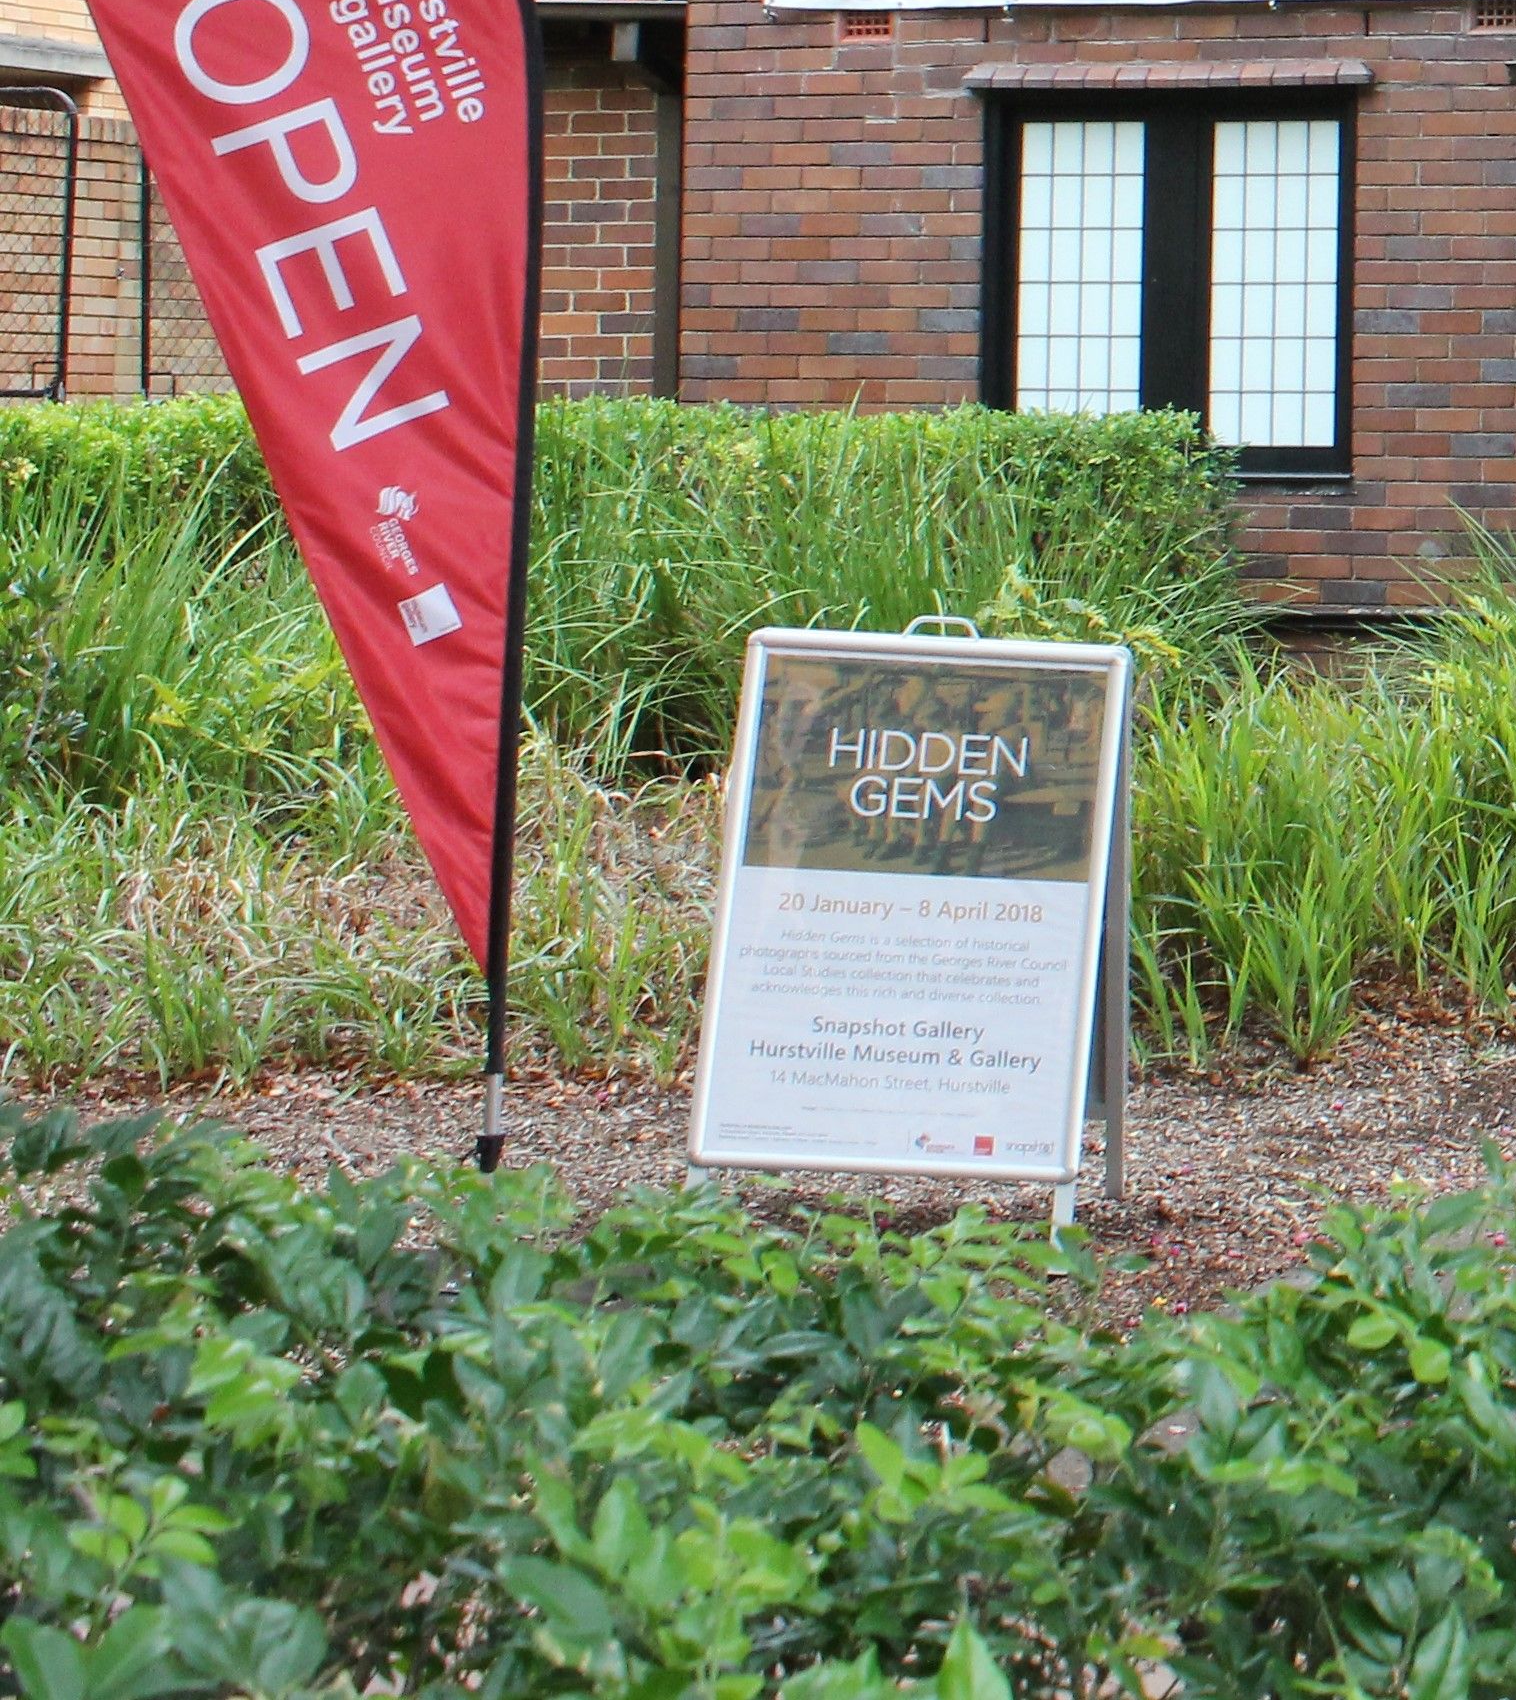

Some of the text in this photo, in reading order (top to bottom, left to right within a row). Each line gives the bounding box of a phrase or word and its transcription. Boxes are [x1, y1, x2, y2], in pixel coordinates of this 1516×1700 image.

[378, 521, 400, 559] RIVER
[389, 518, 418, 576] GEORGES
[828, 727, 1029, 777] HIDDEN
[850, 775, 997, 823] GEMS
[778, 892, 805, 911] 20
[811, 894, 894, 922] January
[919, 900, 930, 918] 8
[937, 901, 988, 924] April
[995, 903, 1042, 923] 2018
[781, 929, 1030, 952] Hidden Gems is a selection of historical
[739, 945, 1066, 972] photographs sourced from the Georges River Council
[763, 964, 1040, 988] Local Studies collection that celebrates and
[751, 981, 842, 997] acknowledges
[847, 984, 869, 998] this
[873, 985, 896, 999] rich
[900, 987, 924, 1000] and
[929, 988, 974, 1002] diverse
[812, 1016, 985, 1045] Snapshot Gallery
[750, 1040, 1042, 1074] Hurstville Museum & Gallery
[770, 1070, 786, 1084] 14
[792, 1071, 879, 1088] MacMahon
[938, 1078, 1011, 1094] Hurstville
